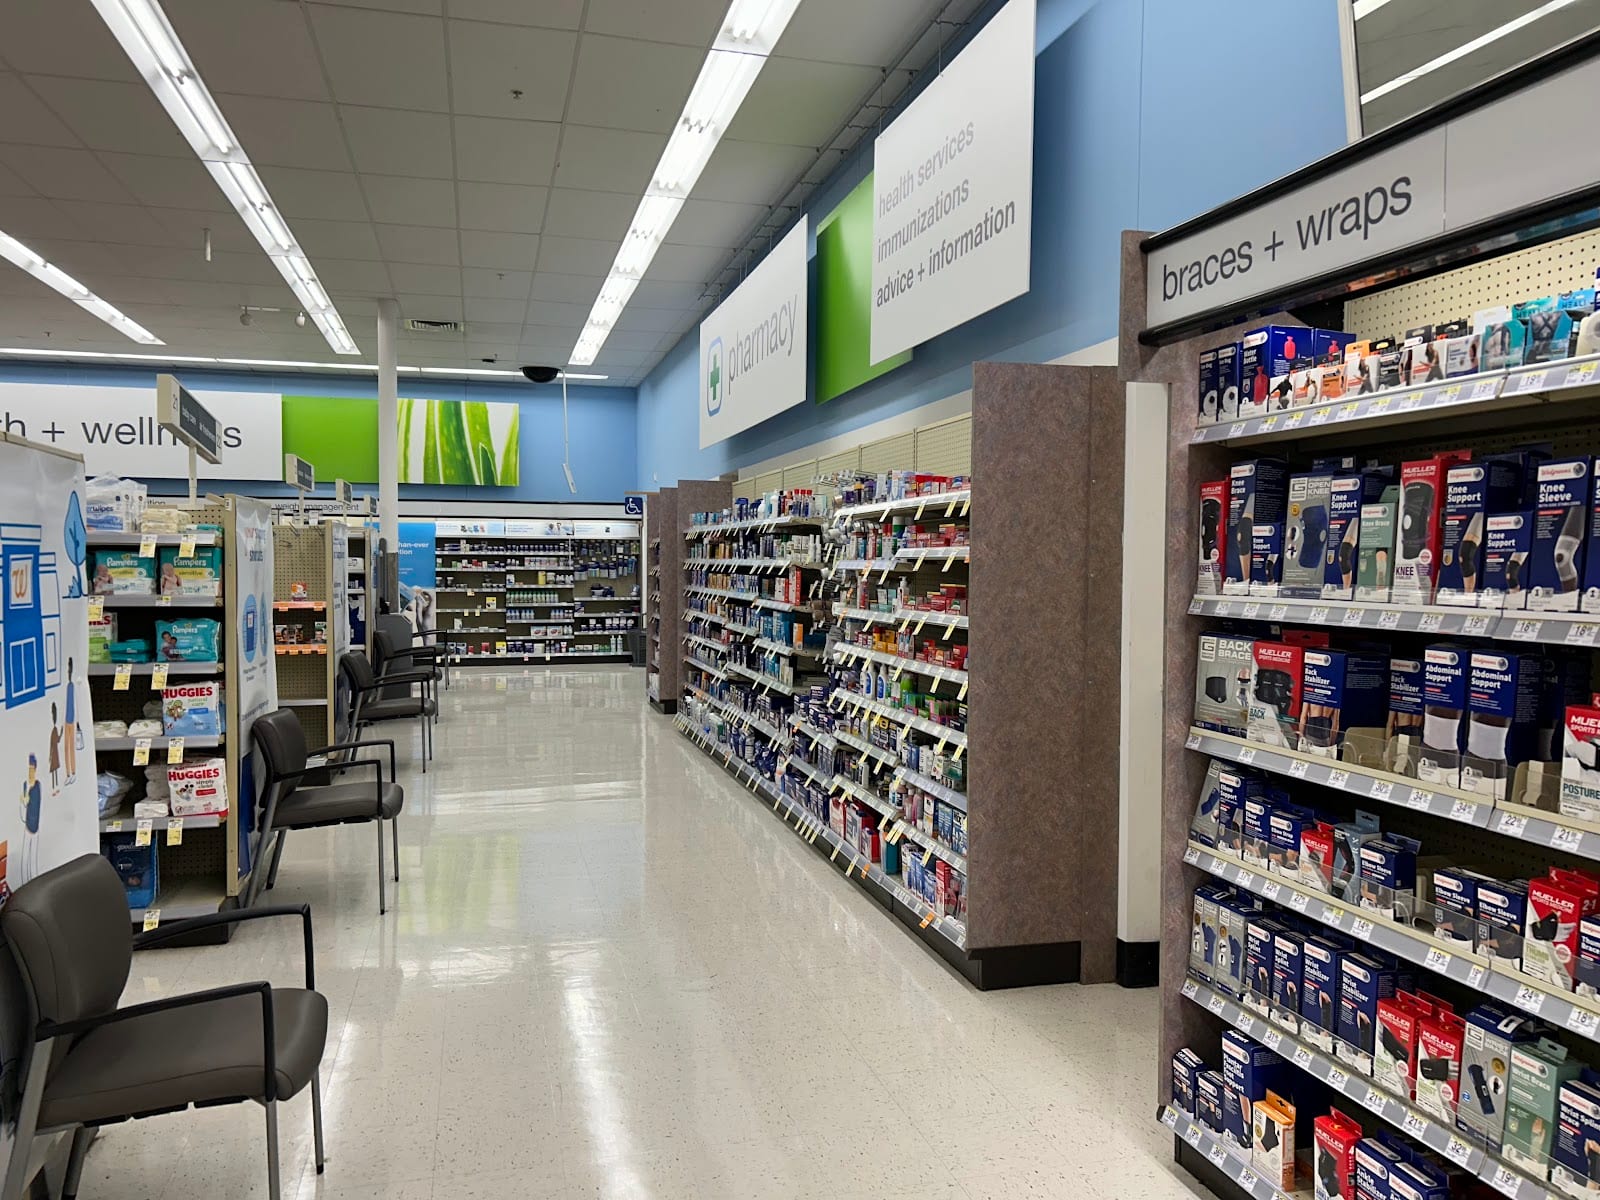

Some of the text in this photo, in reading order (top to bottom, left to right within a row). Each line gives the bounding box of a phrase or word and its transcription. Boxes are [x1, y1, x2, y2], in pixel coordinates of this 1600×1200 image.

[879, 121, 974, 218] health services
[878, 178, 969, 263] immunizations
[1163, 176, 1412, 302] braces + wraps
[876, 201, 1015, 307] advice + information
[728, 294, 798, 395] pharmacy
[42, 422, 64, 442] +
[82, 416, 242, 448] wellns
[1540, 468, 1571, 476] Walgreens
[1448, 486, 1467, 494] Knee
[1540, 483, 1565, 493] Knee
[1447, 493, 1481, 503] Support
[1539, 493, 1571, 503] Sleeve
[275, 503, 300, 511] weigh
[1331, 501, 1357, 509] Support
[1487, 539, 1516, 547] Support
[107, 558, 138, 567] Pampers
[173, 559, 207, 567] Pampers
[1396, 567, 1414, 576] KNEE
[172, 626, 198, 634] Pampers
[1219, 641, 1252, 651] BACK
[1218, 650, 1251, 660] BRACE
[1259, 648, 1293, 657] MUELLER
[1305, 668, 1317, 676] Back
[1425, 664, 1462, 676] Abdominal
[1471, 669, 1512, 682] Abdominal
[1304, 675, 1330, 685] Stabilizer
[1425, 673, 1452, 683] Support
[1471, 677, 1501, 689] Support
[161, 687, 213, 699] HUGGIES
[1390, 683, 1419, 693] Stabilizer
[1570, 725, 1595, 734] SPORTS
[168, 769, 220, 781] HUGGIES
[1563, 783, 1600, 799] POSTURE
[1435, 887, 1470, 904] Elbow Sleeve
[1532, 890, 1575, 909] MUELLER
[1479, 902, 1517, 920] Elbow Sleeve
[1275, 956, 1290, 967] Splint
[1305, 957, 1320, 969] Wrist
[1304, 965, 1330, 982] Stabilizer
[1342, 975, 1357, 988] Wrist
[1342, 983, 1369, 1002] Stabilizer
[1379, 1008, 1410, 1027] MUELLER
[1422, 1030, 1456, 1051] MUELLER
[1224, 1074, 1244, 1093] Support
[1531, 1076, 1551, 1091] Brace
[1560, 1103, 1579, 1119] Wrist
[1560, 1111, 1580, 1128] Brace
[1357, 1167, 1374, 1185] Ankle
[1357, 1176, 1387, 1200] Stabilizer
